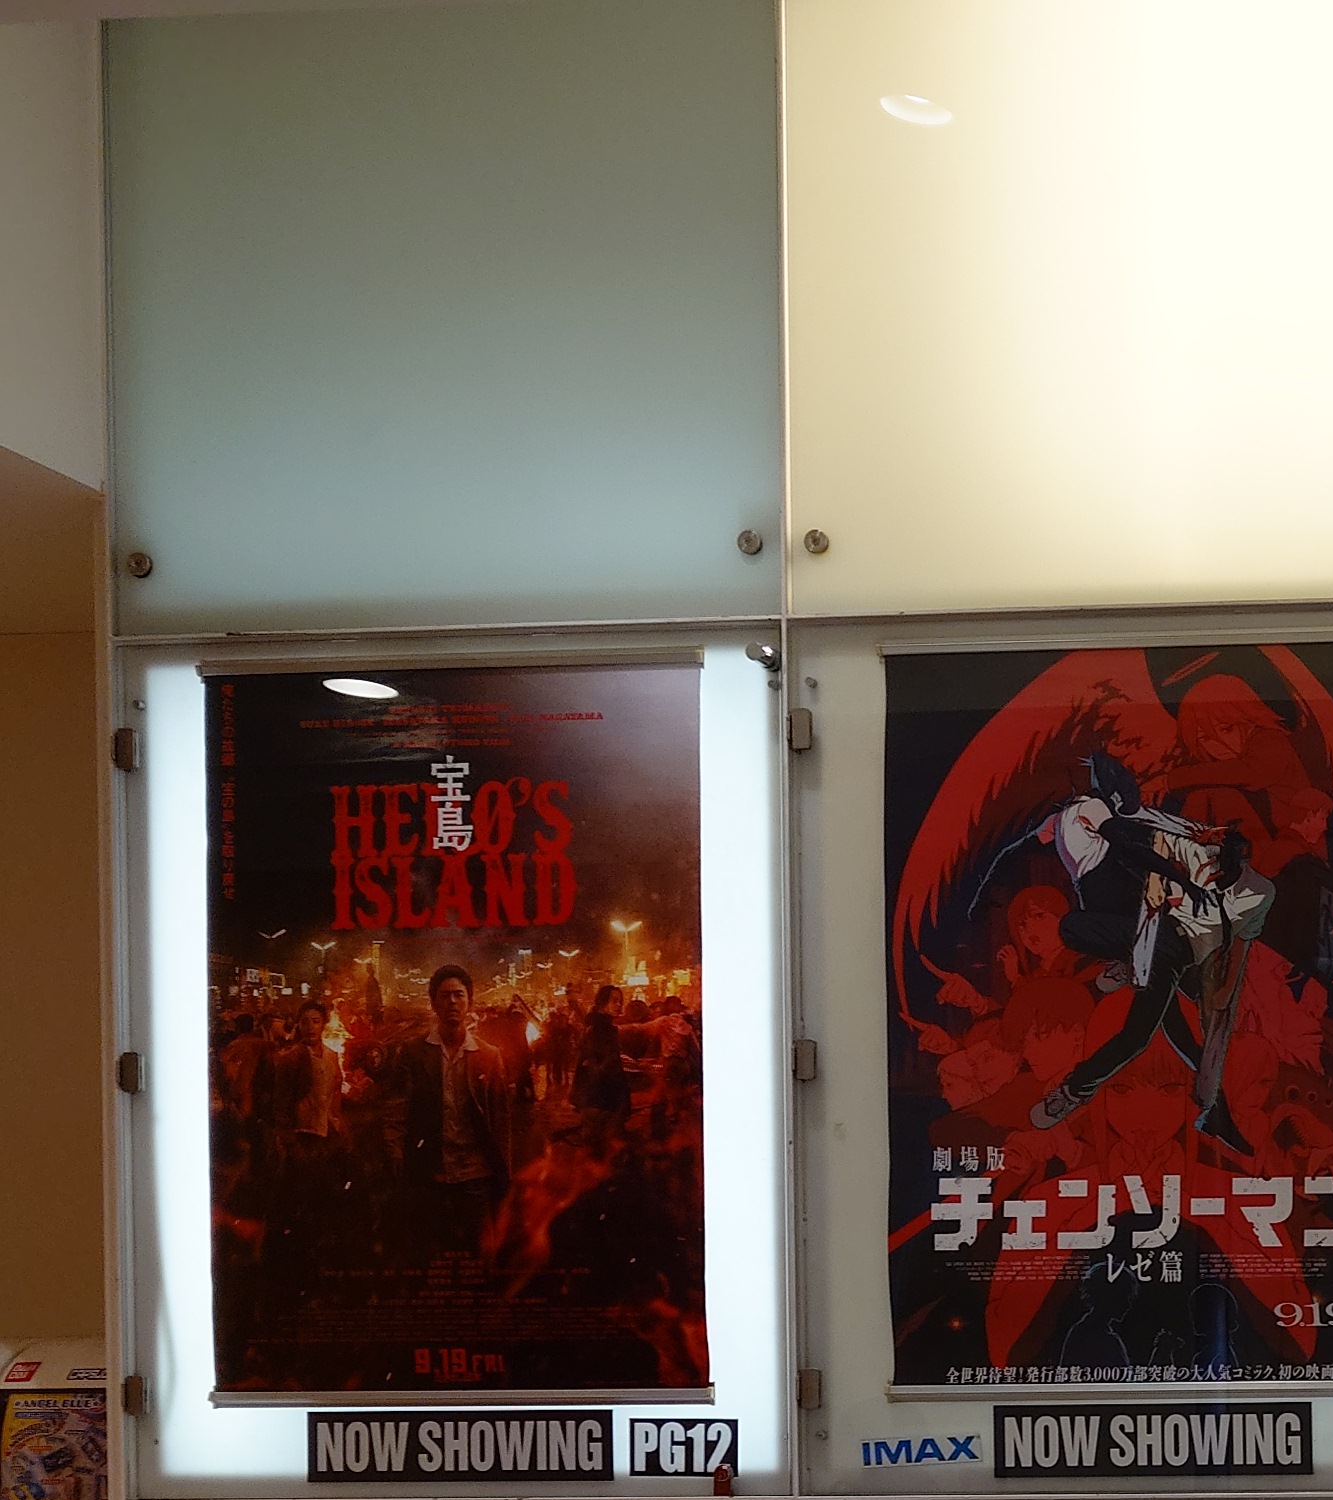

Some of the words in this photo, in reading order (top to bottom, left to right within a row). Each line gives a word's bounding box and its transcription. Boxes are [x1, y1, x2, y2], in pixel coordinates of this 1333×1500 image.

[430, 755, 474, 851] 宝島
[331, 852, 579, 931] ISLAND
[932, 1145, 1006, 1173] 劇場版
[1105, 1249, 1185, 1286] レゼ篇
[317, 1421, 411, 1472] NOW
[417, 1419, 604, 1472] SHOWING
[634, 1422, 734, 1474] PG12
[863, 1435, 980, 1466] IMAX
[1003, 1416, 1100, 1470] NOW
[1109, 1412, 1302, 1467] SHOWING
